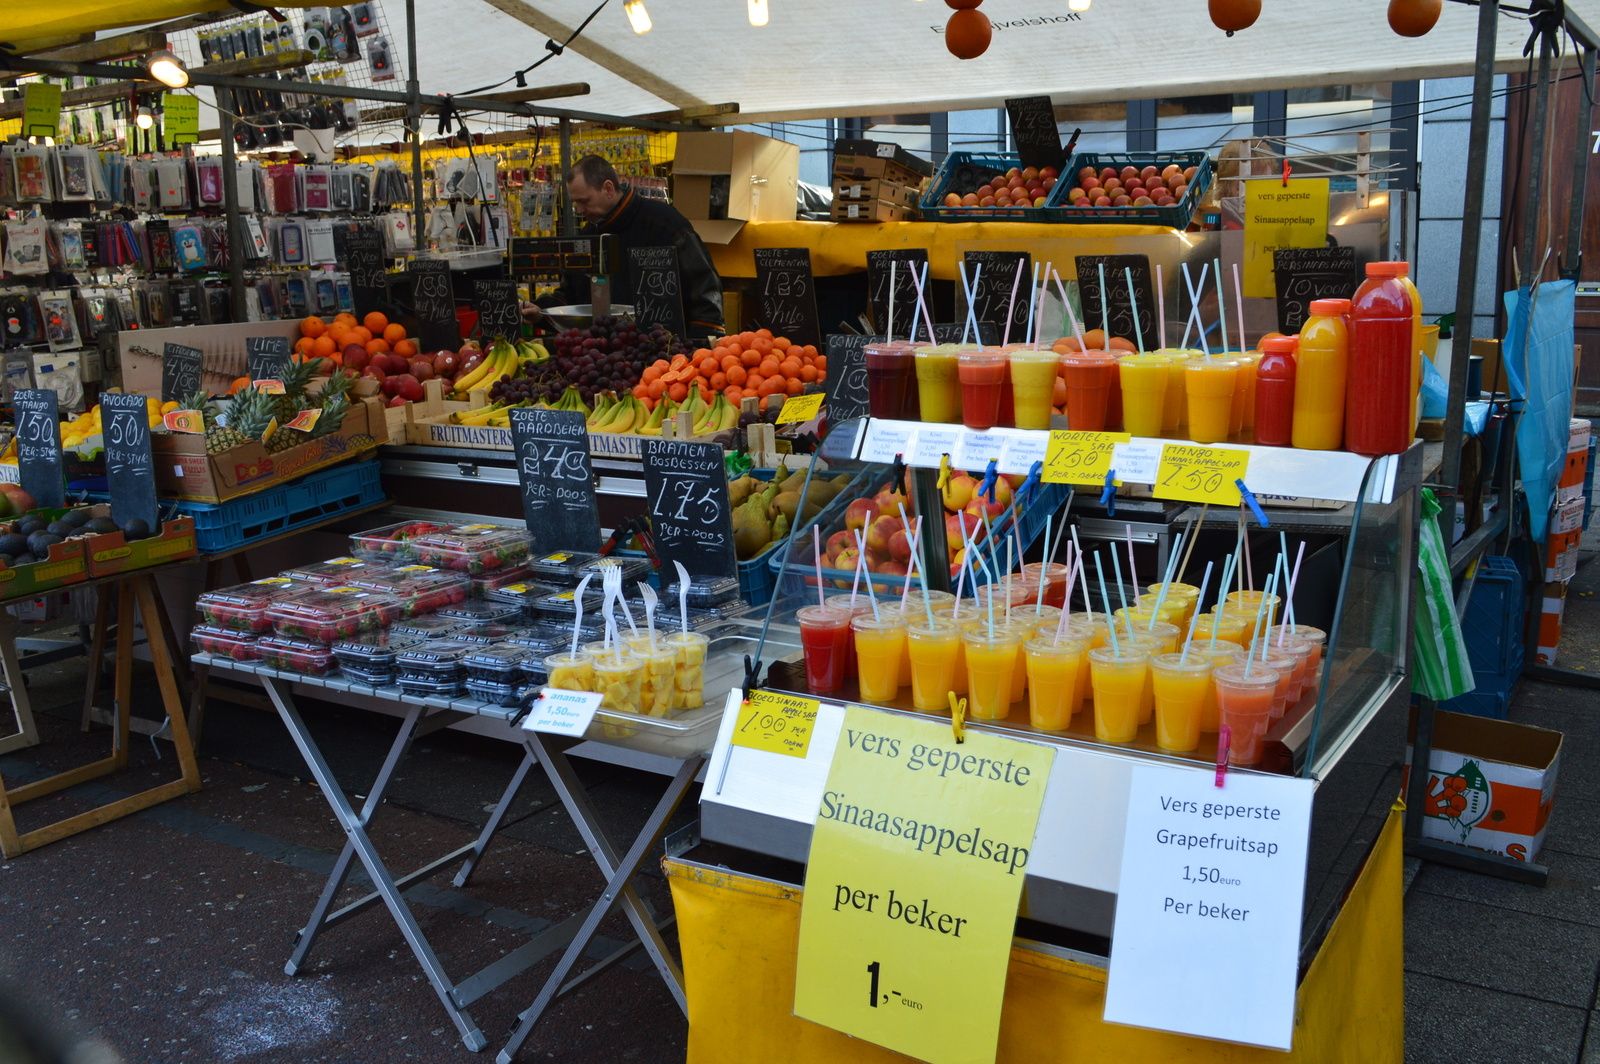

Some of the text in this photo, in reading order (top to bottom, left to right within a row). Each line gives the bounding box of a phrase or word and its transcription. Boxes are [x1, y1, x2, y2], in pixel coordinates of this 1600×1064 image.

[1257, 191, 1311, 202] vers geperste
[1254, 214, 1315, 226] Sinaasappelsap
[102, 393, 144, 408] AVOCADO
[512, 410, 548, 422] ZOETE
[647, 440, 707, 458] BRAMEN
[650, 455, 720, 471] BOSBESSEN
[550, 692, 588, 704] ananas
[537, 719, 576, 728] per beker
[846, 728, 1032, 787] vers geperste
[1159, 795, 1282, 821] Vers geperste
[818, 790, 1031, 876] Sinaasappelsap
[1156, 828, 1279, 858] Grapefruitsap
[832, 882, 968, 939] per beker
[1163, 896, 1250, 922] Per beker
